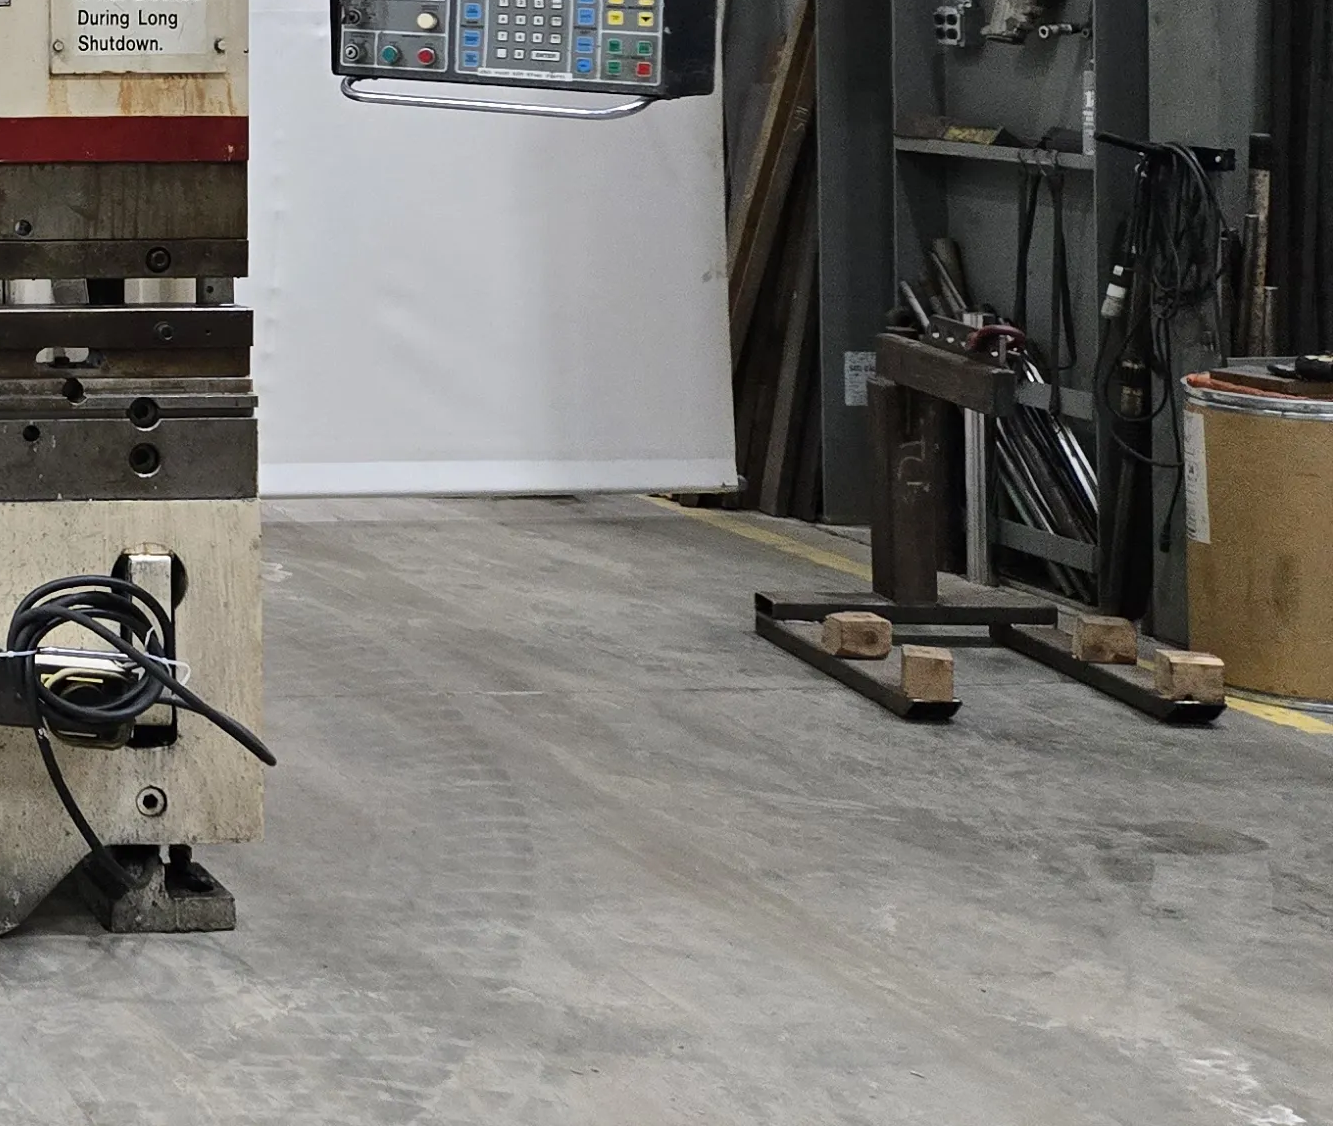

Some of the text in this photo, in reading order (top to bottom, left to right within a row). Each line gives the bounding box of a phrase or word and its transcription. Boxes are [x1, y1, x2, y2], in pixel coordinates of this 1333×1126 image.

[77, 10, 179, 29] During Long
[77, 35, 164, 52] Shutdown.
